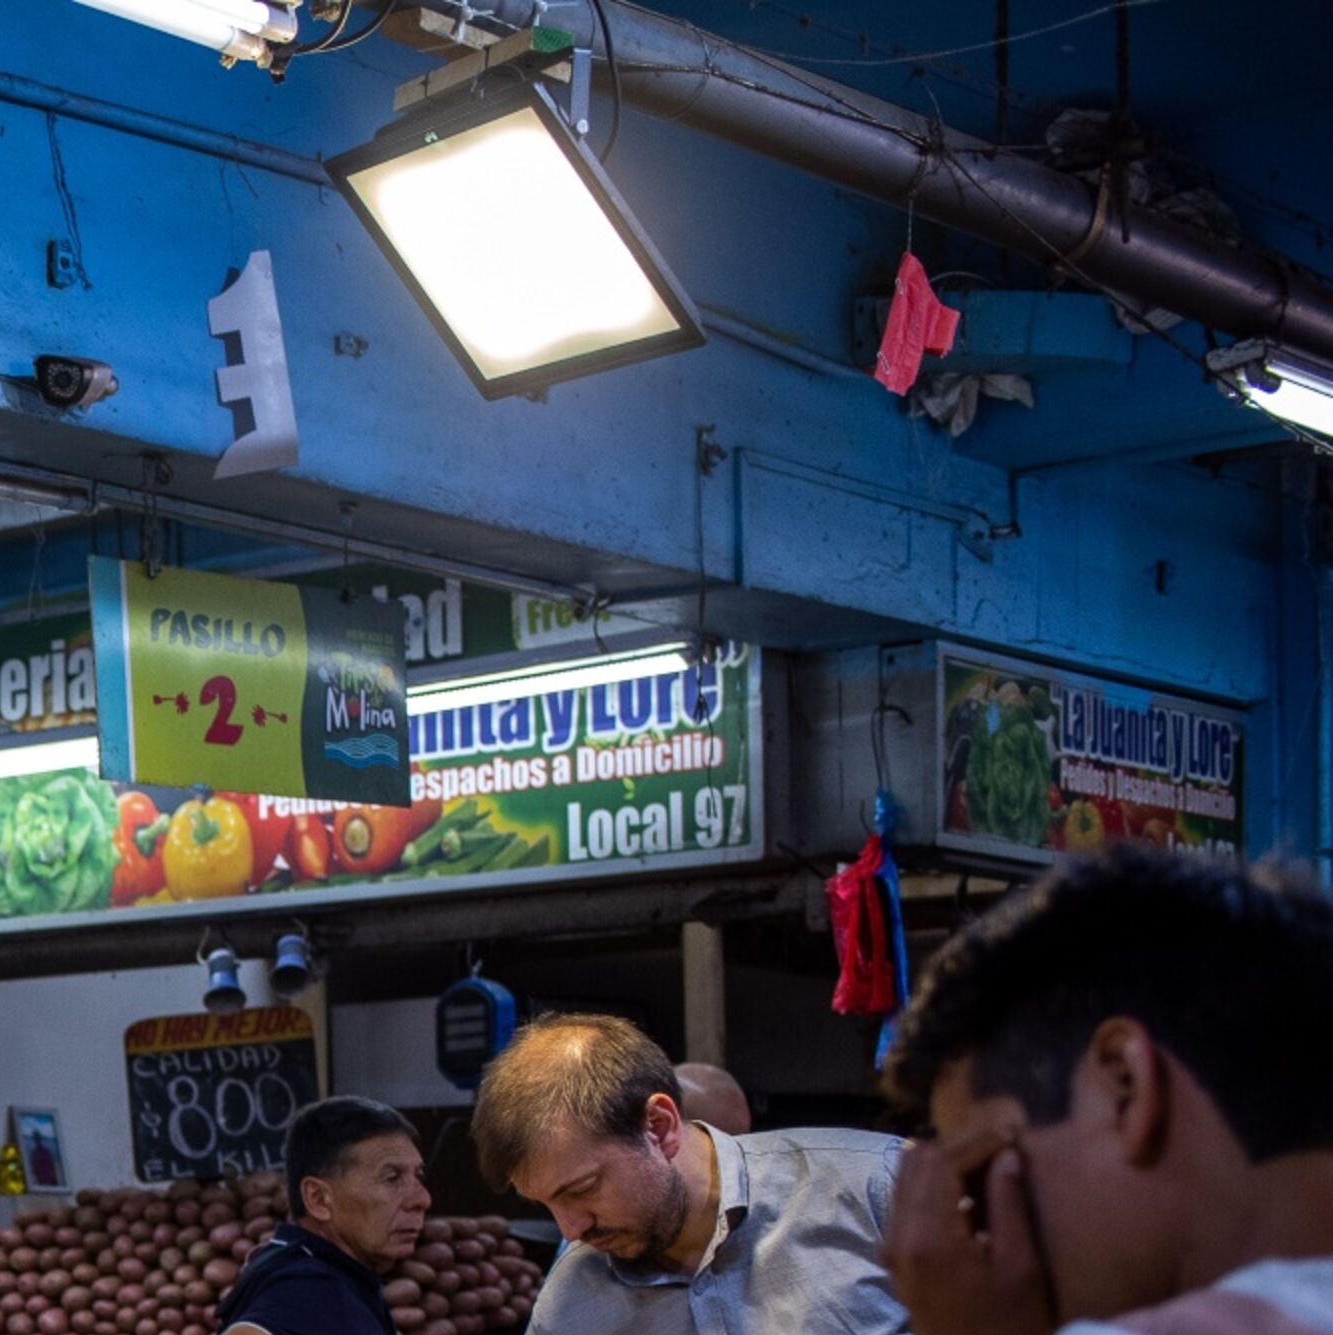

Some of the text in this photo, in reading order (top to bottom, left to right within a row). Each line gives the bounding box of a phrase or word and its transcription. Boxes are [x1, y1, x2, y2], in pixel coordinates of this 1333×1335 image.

[149, 607, 287, 658] PASILLO
[199, 675, 244, 746] 2
[551, 757, 571, 786] a
[576, 732, 724, 783] Domicilio
[567, 785, 746, 862] Local 97
[132, 1043, 282, 1078] CALIDAD
[166, 1072, 296, 1160] 800
[143, 1157, 196, 1181] EL
